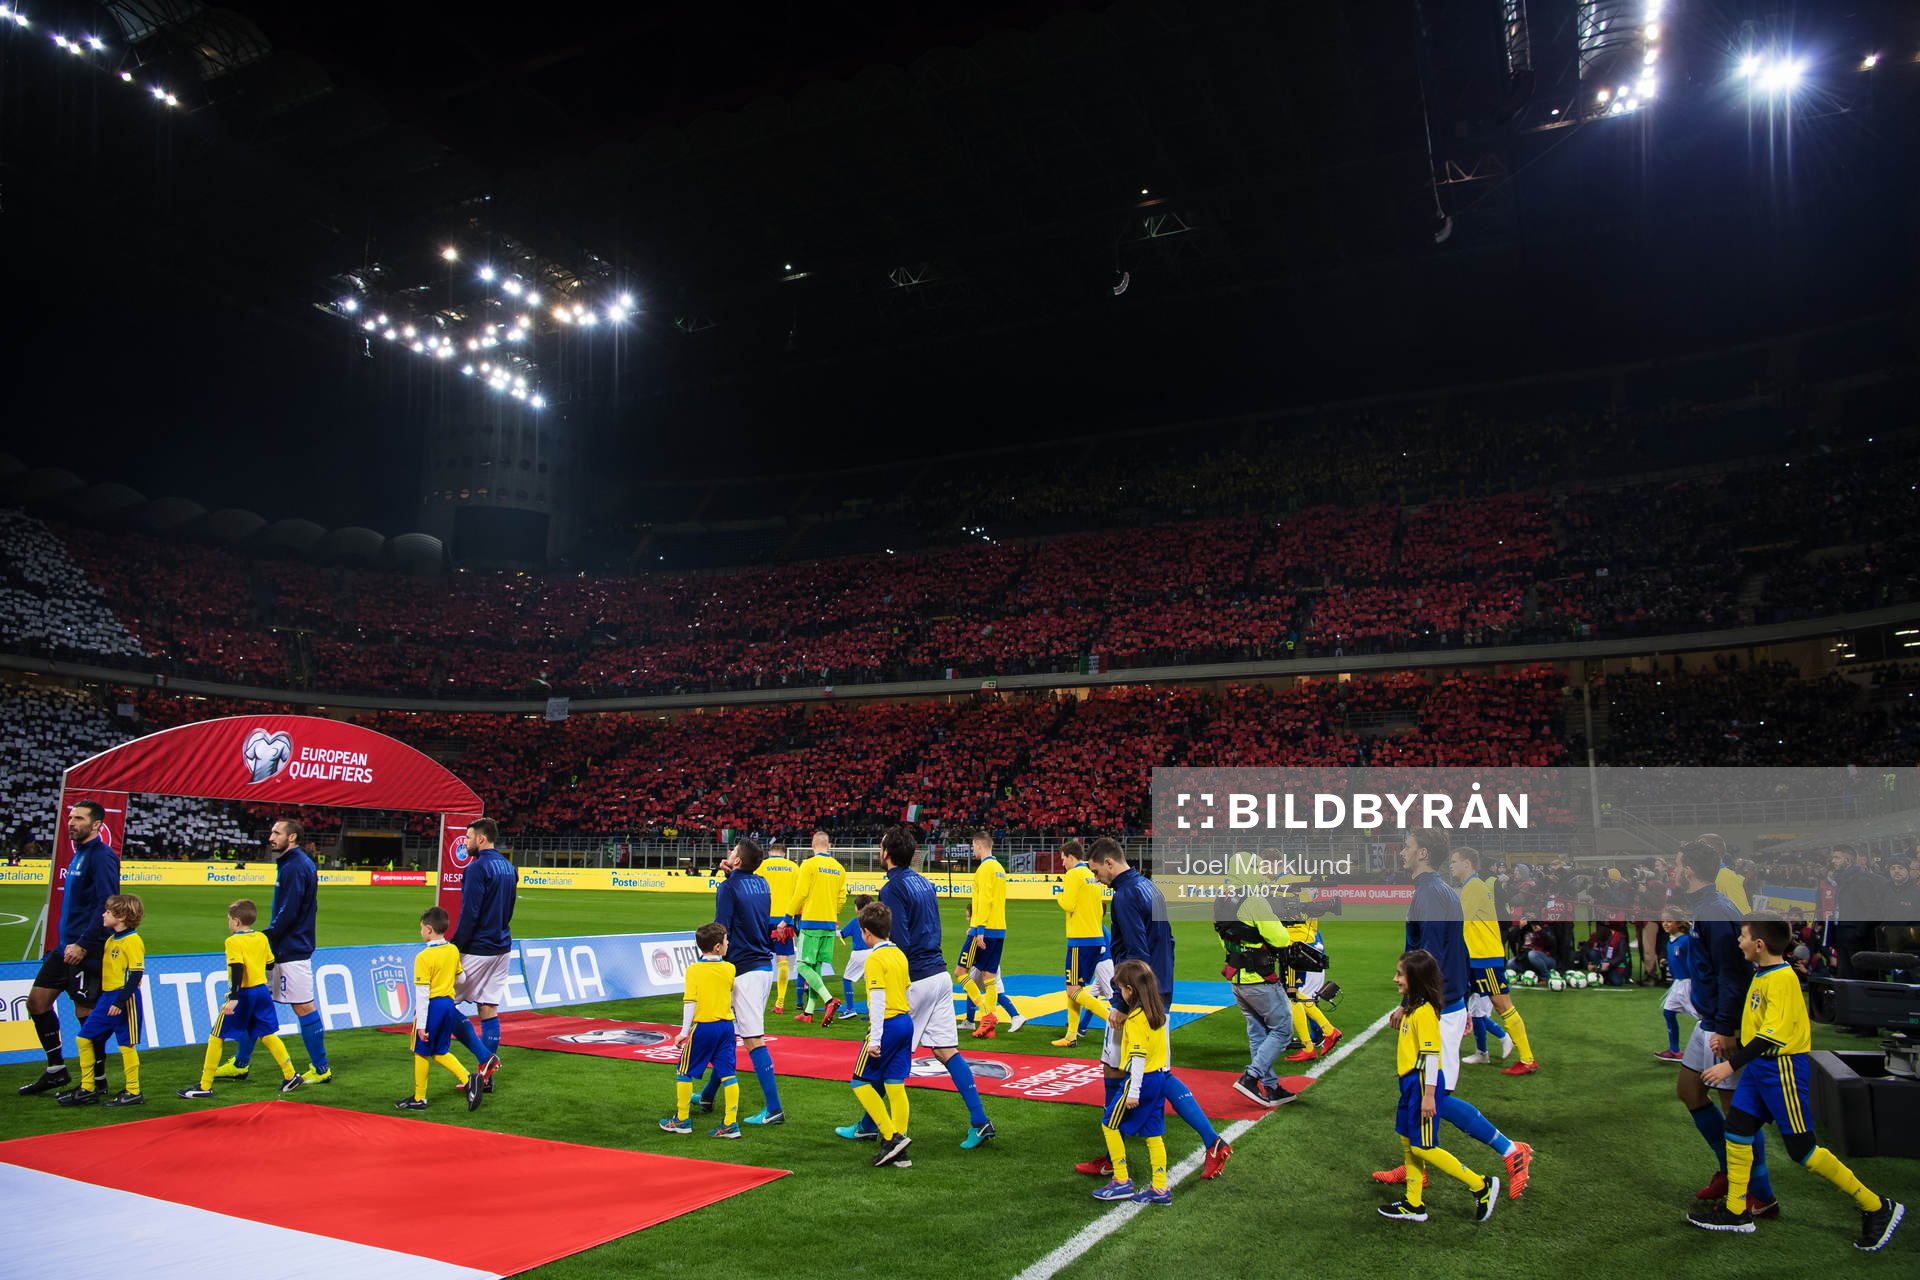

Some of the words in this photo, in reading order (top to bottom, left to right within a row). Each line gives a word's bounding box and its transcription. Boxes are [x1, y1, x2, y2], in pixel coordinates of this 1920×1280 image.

[301, 747, 368, 766] EUROPEAN
[289, 761, 373, 783] QUALIFIERS
[0, 871, 43, 881] eitaliane
[120, 872, 162, 882] eitaliane
[207, 872, 265, 882] Posteitaliane
[319, 874, 355, 882] teitaliane
[443, 873, 463, 883] RESP
[523, 876, 572, 886] Posteitaliane
[612, 878, 665, 888] Posteitaliane
[846, 882, 876, 892] taliane
[1321, 889, 1367, 898] EUROPEAN
[960, 952, 968, 965] 2
[375, 969, 403, 980] ITALIA
[502, 945, 605, 1008] EZIA
[75, 971, 84, 990] 1
[280, 975, 287, 992] 3
[1476, 978, 1491, 993] 17
